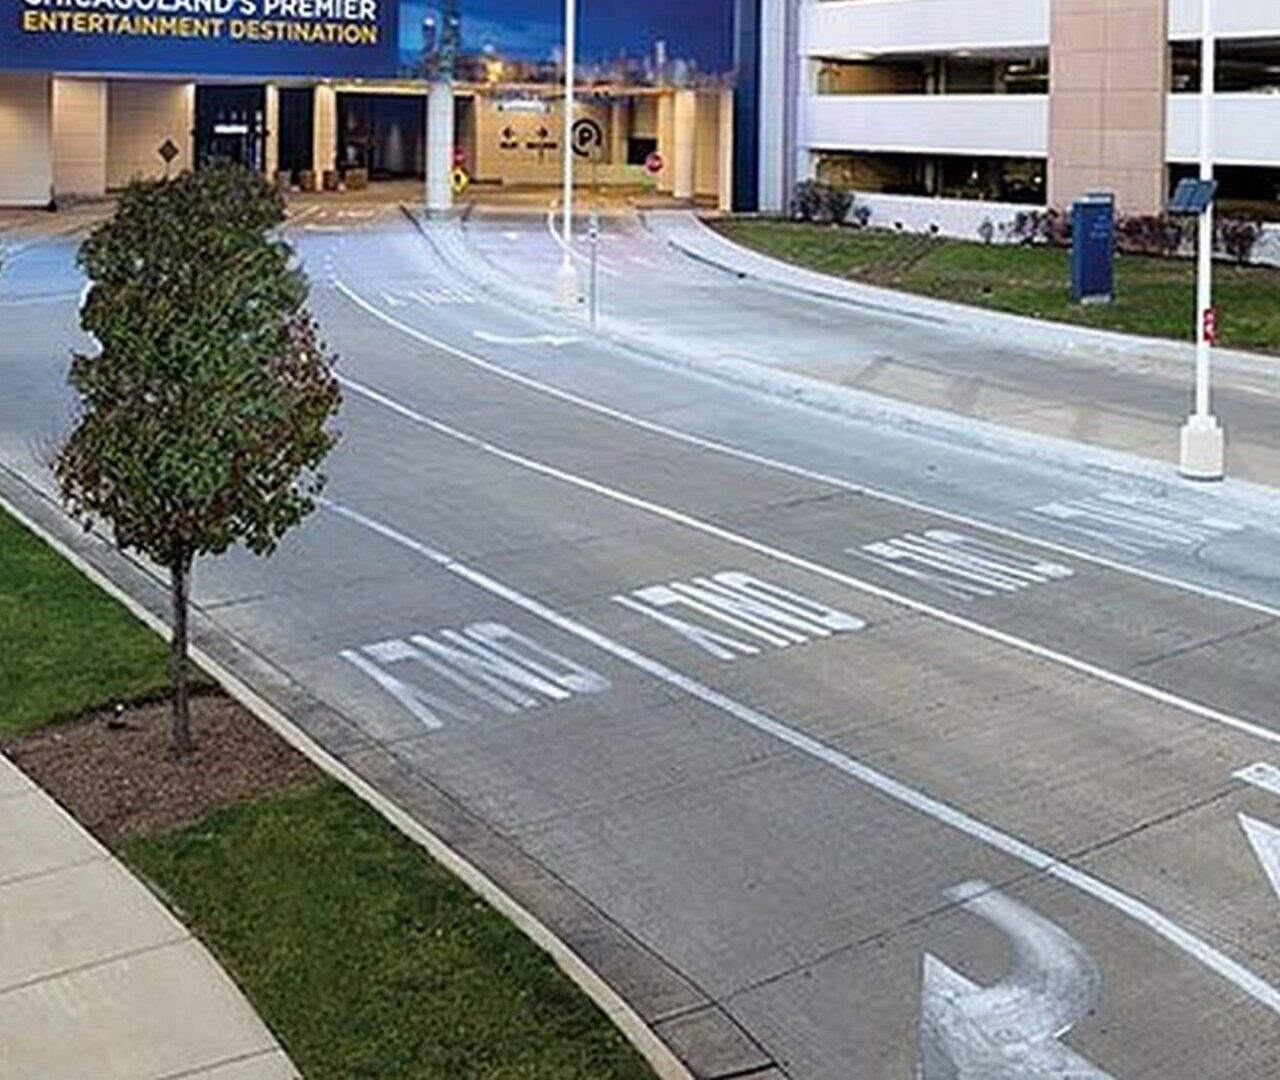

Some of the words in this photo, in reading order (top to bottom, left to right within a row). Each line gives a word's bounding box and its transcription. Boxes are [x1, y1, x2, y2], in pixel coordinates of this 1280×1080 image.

[24, 10, 223, 38] ENTERTAINMENT
[229, 20, 377, 44] DESTINATION
[845, 530, 1074, 600] ONLY
[611, 570, 867, 661] ONLY
[339, 622, 612, 729] ONLY
